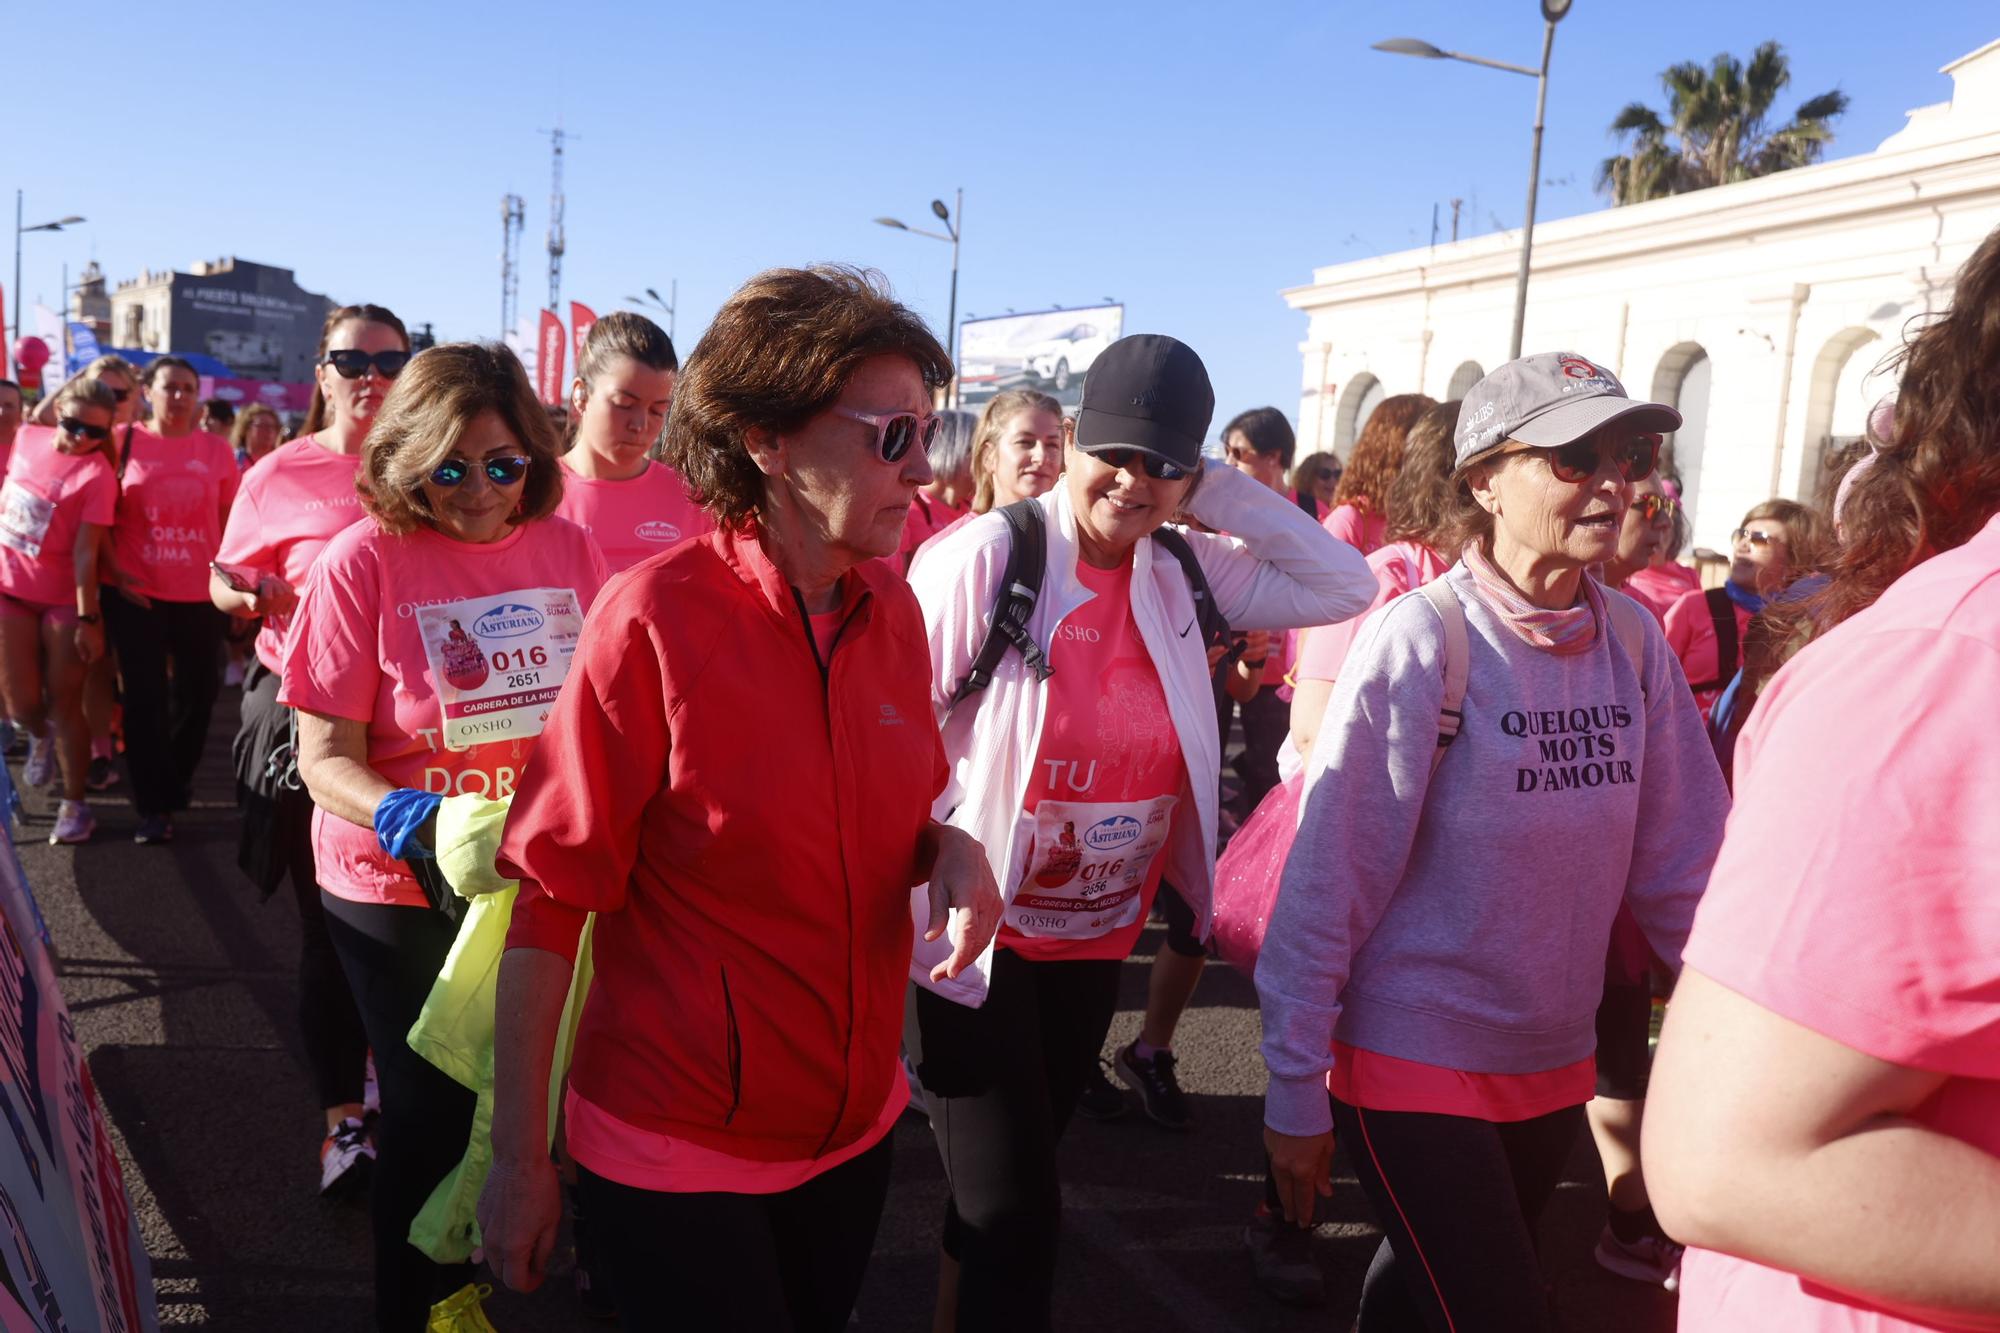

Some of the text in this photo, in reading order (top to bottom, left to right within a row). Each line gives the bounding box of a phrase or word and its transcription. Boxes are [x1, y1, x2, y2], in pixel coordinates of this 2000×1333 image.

[151, 527, 206, 543] ORSAL
[546, 607, 571, 616] SUMA
[480, 617, 541, 634] ASTURIANA
[1056, 624, 1100, 643] YSHO
[491, 646, 548, 672] 016
[507, 671, 541, 688] 2651
[463, 689, 560, 713] CARRERA DE LA MUJ
[461, 718, 512, 736] OYSHO
[1538, 733, 1616, 763] MOTS
[424, 764, 527, 799] DOR
[1043, 759, 1097, 792] TU
[1516, 760, 1636, 792] D'AMOUR
[1089, 829, 1137, 843] ASTURIANA
[1080, 859, 1124, 880] 016
[1030, 899, 1072, 909] CARRERA
[1019, 914, 1066, 929] OYSHO
